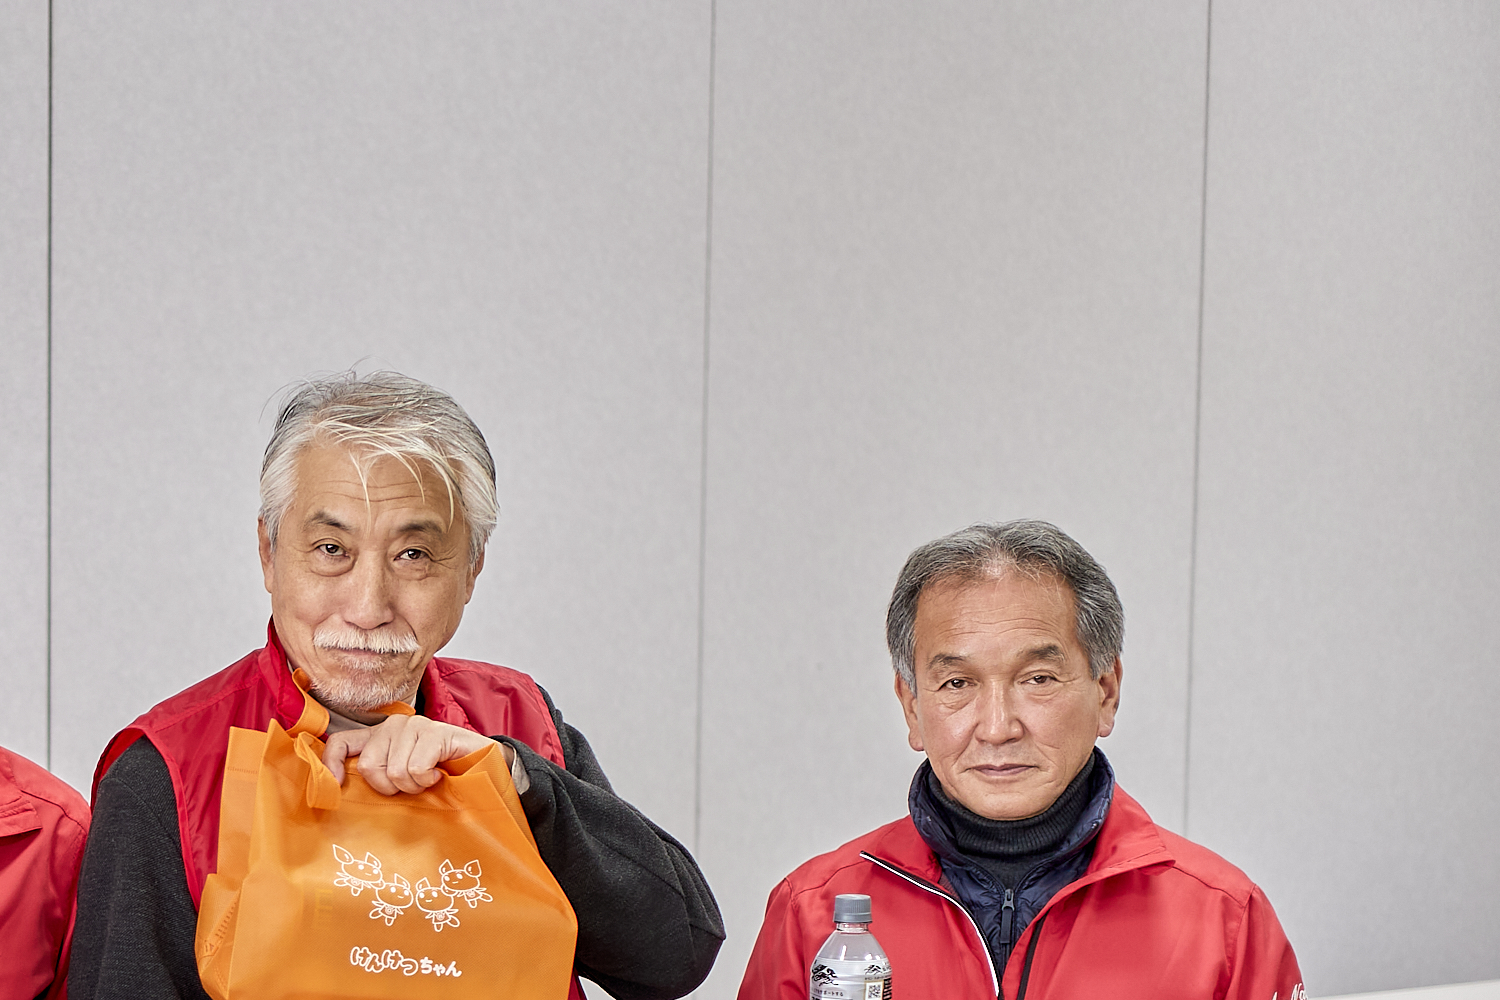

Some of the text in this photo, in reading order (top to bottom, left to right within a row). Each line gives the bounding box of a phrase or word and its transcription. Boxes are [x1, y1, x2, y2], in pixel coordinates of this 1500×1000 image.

[350, 946, 463, 978] けんけつちゃん
